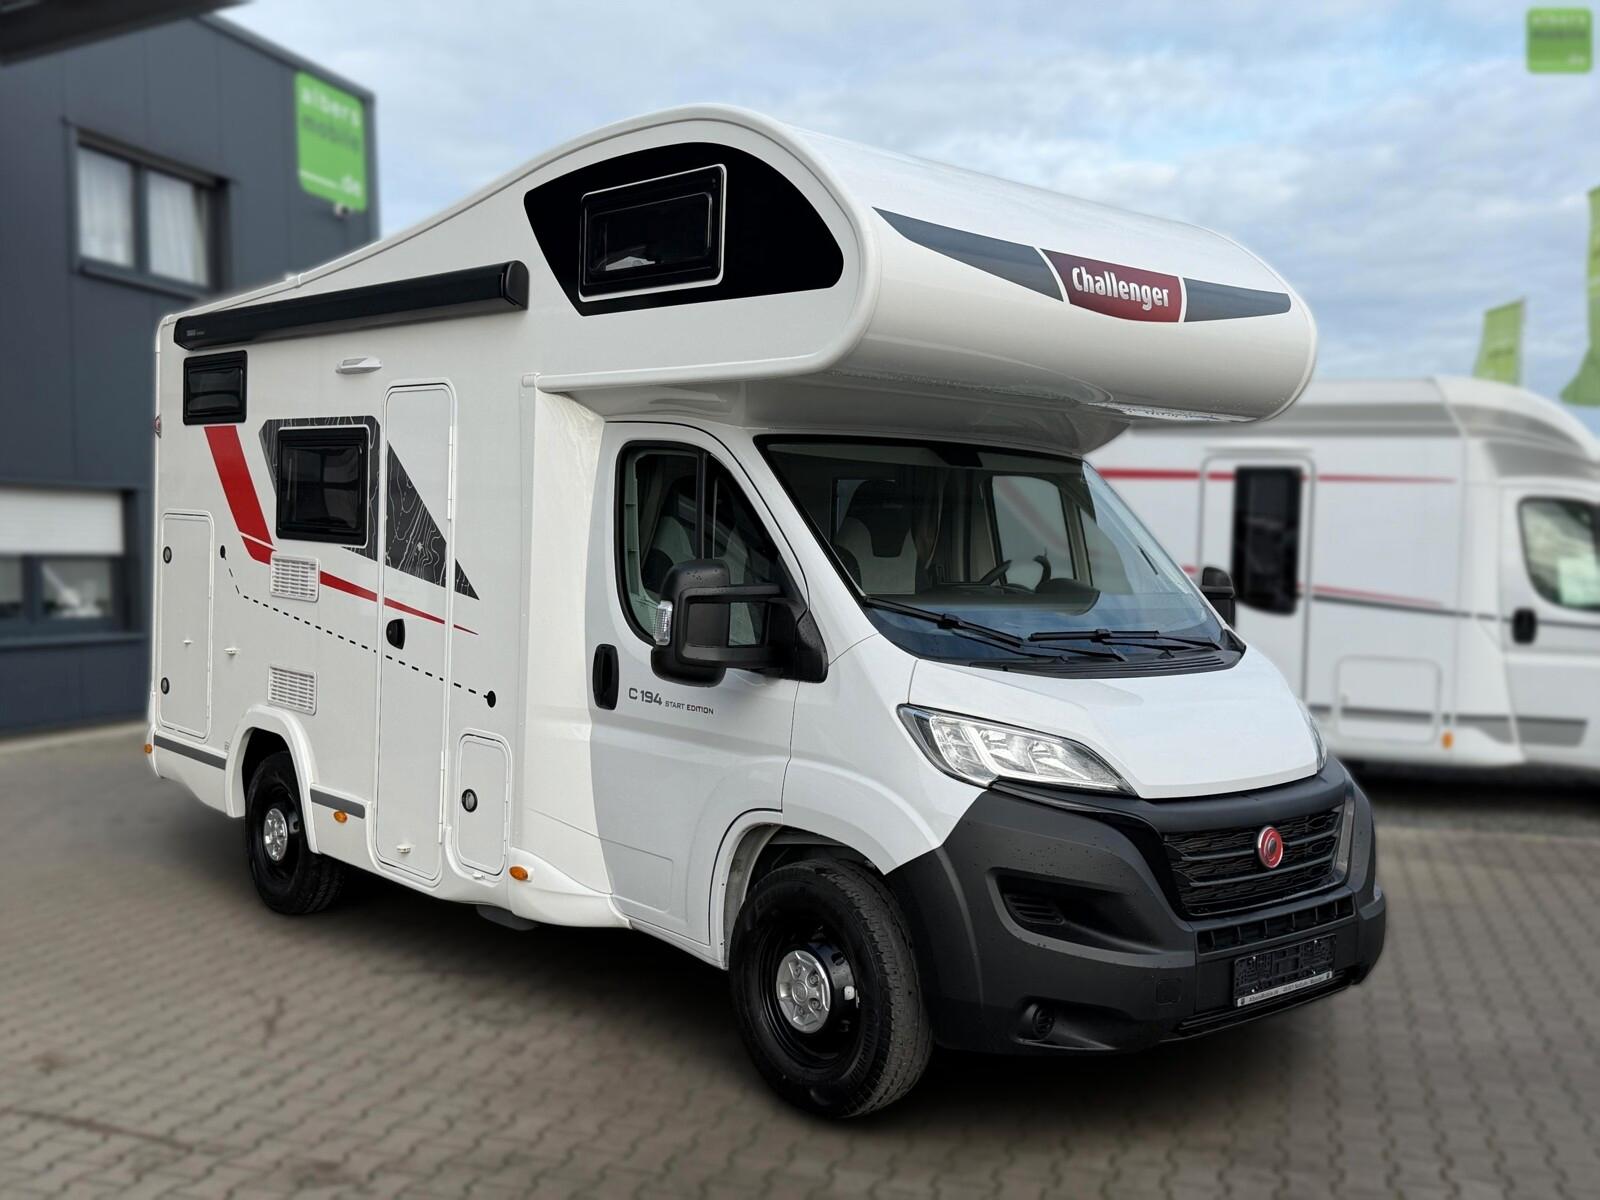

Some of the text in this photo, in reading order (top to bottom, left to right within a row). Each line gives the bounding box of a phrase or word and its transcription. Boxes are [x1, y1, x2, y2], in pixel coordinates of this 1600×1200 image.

[1071, 266, 1169, 311] Challenger
[628, 687, 714, 715] C 194 START EDITION
